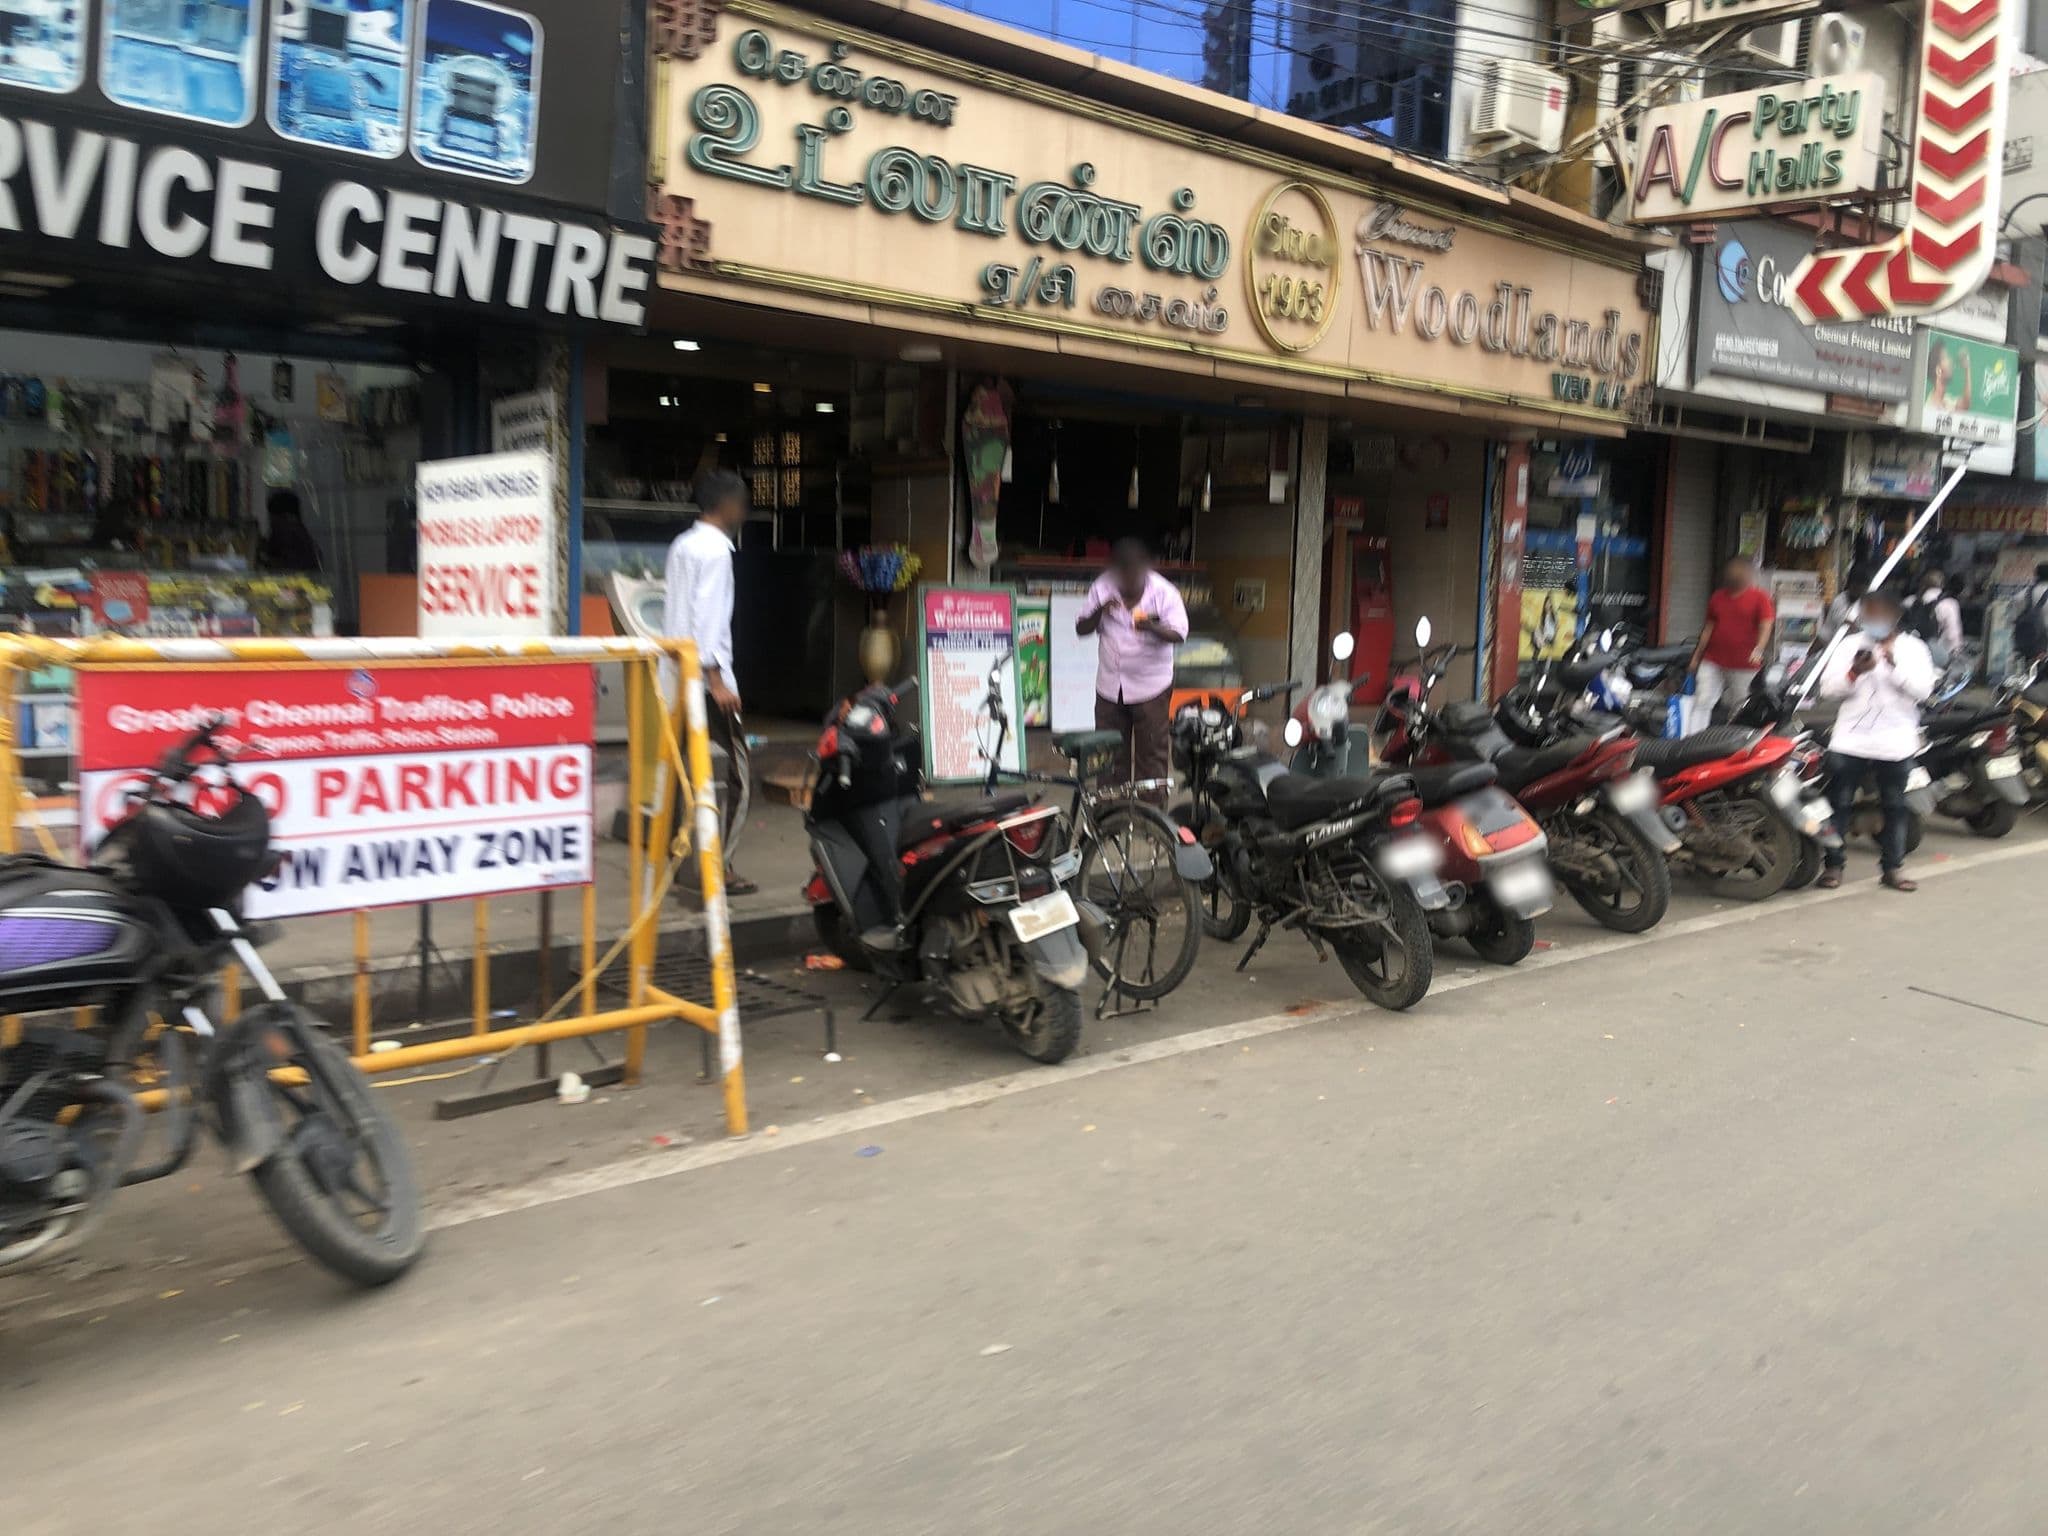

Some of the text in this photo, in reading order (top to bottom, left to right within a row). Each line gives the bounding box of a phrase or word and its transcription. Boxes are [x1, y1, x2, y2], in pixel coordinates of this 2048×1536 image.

[1636, 84, 1861, 206] A/C Party
[1746, 142, 1843, 196] Halls
[316, 180, 657, 326] CENTRE
[1356, 245, 1642, 379] Woodlands
[421, 562, 540, 618] SERVICE
[246, 700, 374, 727] Chennai
[491, 692, 574, 719] Police
[315, 755, 582, 818] PARKING
[341, 837, 460, 883] AWAY
[477, 826, 581, 869] ZONE
[1306, 818, 1353, 849] PLATINA
